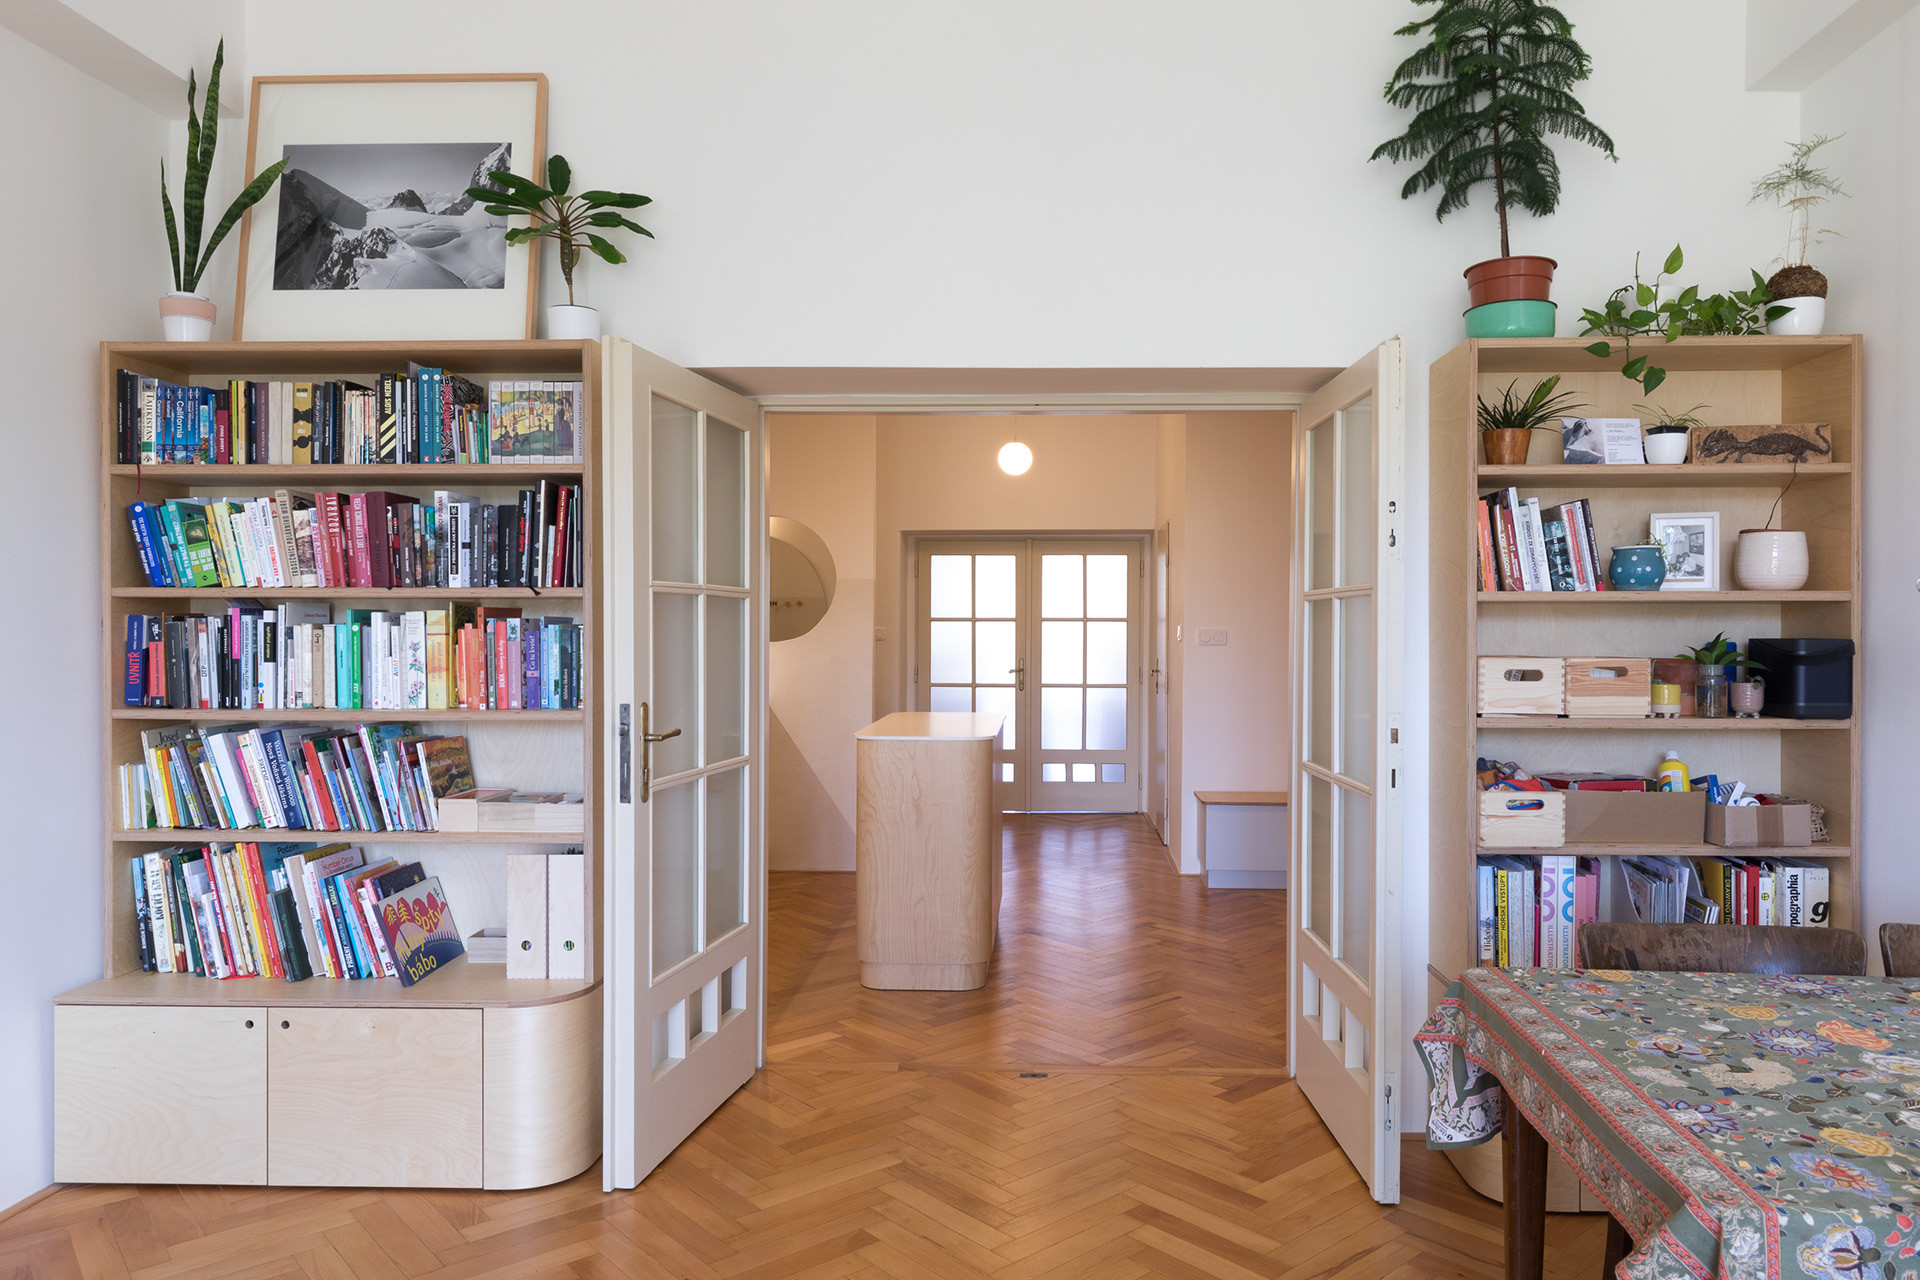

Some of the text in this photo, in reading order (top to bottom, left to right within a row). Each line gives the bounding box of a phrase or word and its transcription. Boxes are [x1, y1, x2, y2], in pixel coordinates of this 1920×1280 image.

[146, 393, 154, 441] TAJIKISTAN
[176, 400, 184, 438] California
[326, 496, 339, 533] ROZVRAT
[256, 528, 264, 547] RADOST
[279, 500, 299, 577] TROSEČNÍCI POLÁRNÍHO MOŘE
[268, 546, 281, 577] FAKTOMLUVA
[1503, 554, 1511, 576] RADOST
[528, 635, 536, 653] kvete?
[128, 652, 141, 684] UVNITŘ
[529, 660, 536, 670] Co
[497, 673, 505, 688] DENÍK
[158, 729, 181, 746] Josef
[266, 742, 276, 760] Nová
[270, 760, 283, 784] Voňavá
[274, 740, 285, 764] VALERIE
[283, 776, 296, 806] WORWOOD
[275, 785, 288, 809] lékárna
[277, 843, 300, 855] Podzim
[321, 855, 355, 872] Number Circus
[150, 869, 165, 921] KOČIČÍ KRÁL
[1724, 878, 1732, 913] DRAWING
[414, 904, 444, 933] špity
[407, 953, 437, 981] bábo
